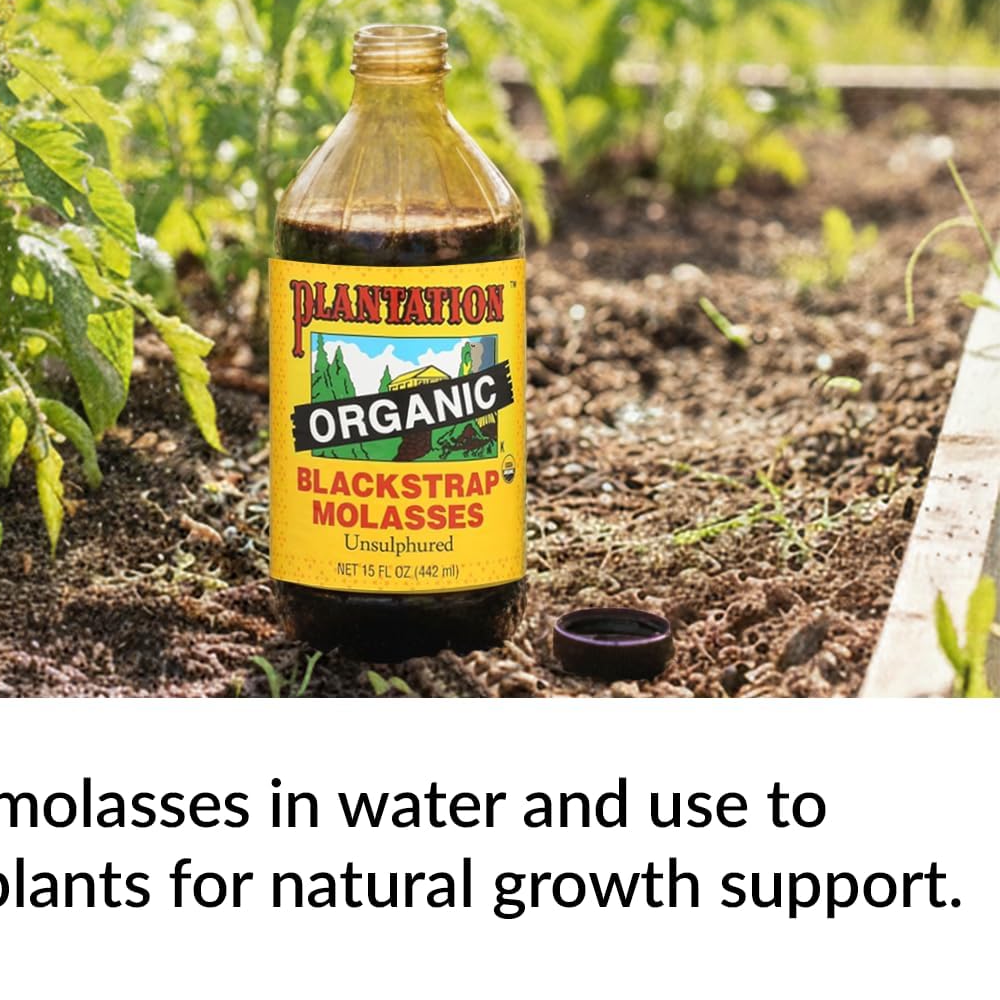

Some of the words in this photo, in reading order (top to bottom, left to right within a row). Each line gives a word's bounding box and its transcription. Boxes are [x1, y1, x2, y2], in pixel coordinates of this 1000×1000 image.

[290, 279, 504, 358] PLANTATION
[308, 374, 498, 445] ORGANIC
[296, 467, 499, 499] BLACKSTRAP
[312, 500, 485, 530] MOLASSES
[344, 533, 455, 557] Unsulphured
[337, 562, 359, 576] NET
[362, 564, 376, 577] 15
[378, 564, 392, 578] FL
[395, 565, 412, 579] OZ
[414, 564, 439, 580] (442
[442, 564, 460, 580] ml)
